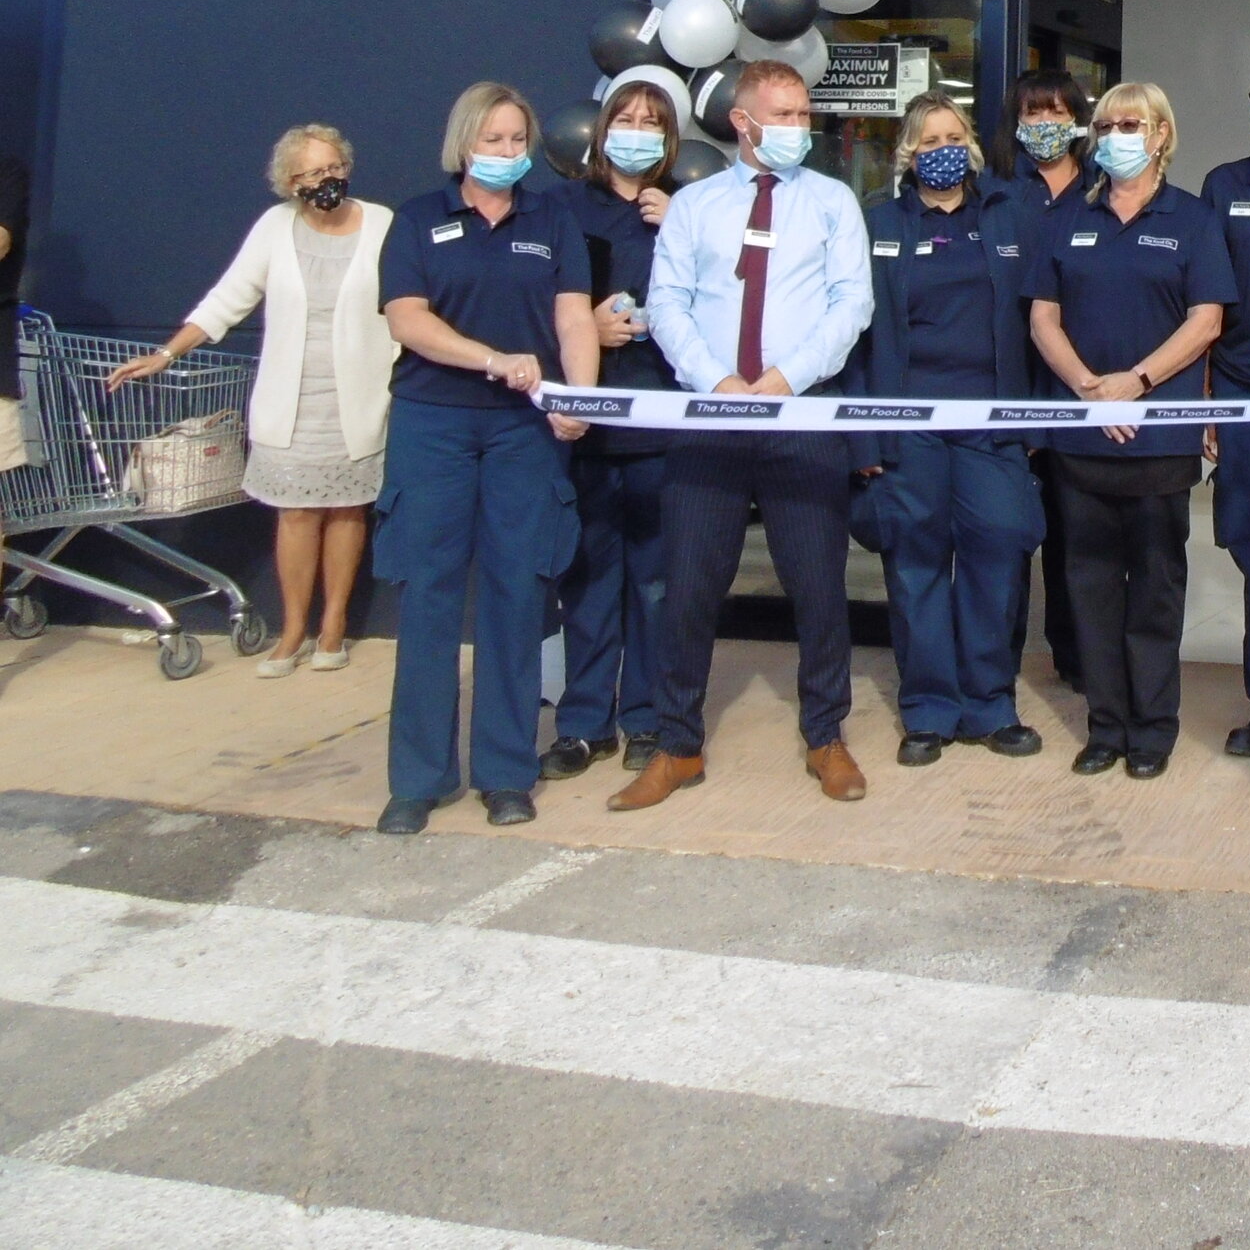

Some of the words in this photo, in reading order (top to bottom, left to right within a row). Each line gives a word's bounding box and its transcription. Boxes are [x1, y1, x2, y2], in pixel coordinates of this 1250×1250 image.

[820, 73, 888, 85] CAPACITY
[551, 400, 570, 410] The
[572, 400, 601, 411] Food
[602, 401, 621, 411] Co.
[697, 403, 717, 412] The
[720, 403, 749, 413] Food
[751, 405, 769, 413] Co.
[847, 407, 868, 415] The
[871, 408, 900, 416] Food
[902, 409, 921, 417] Co.
